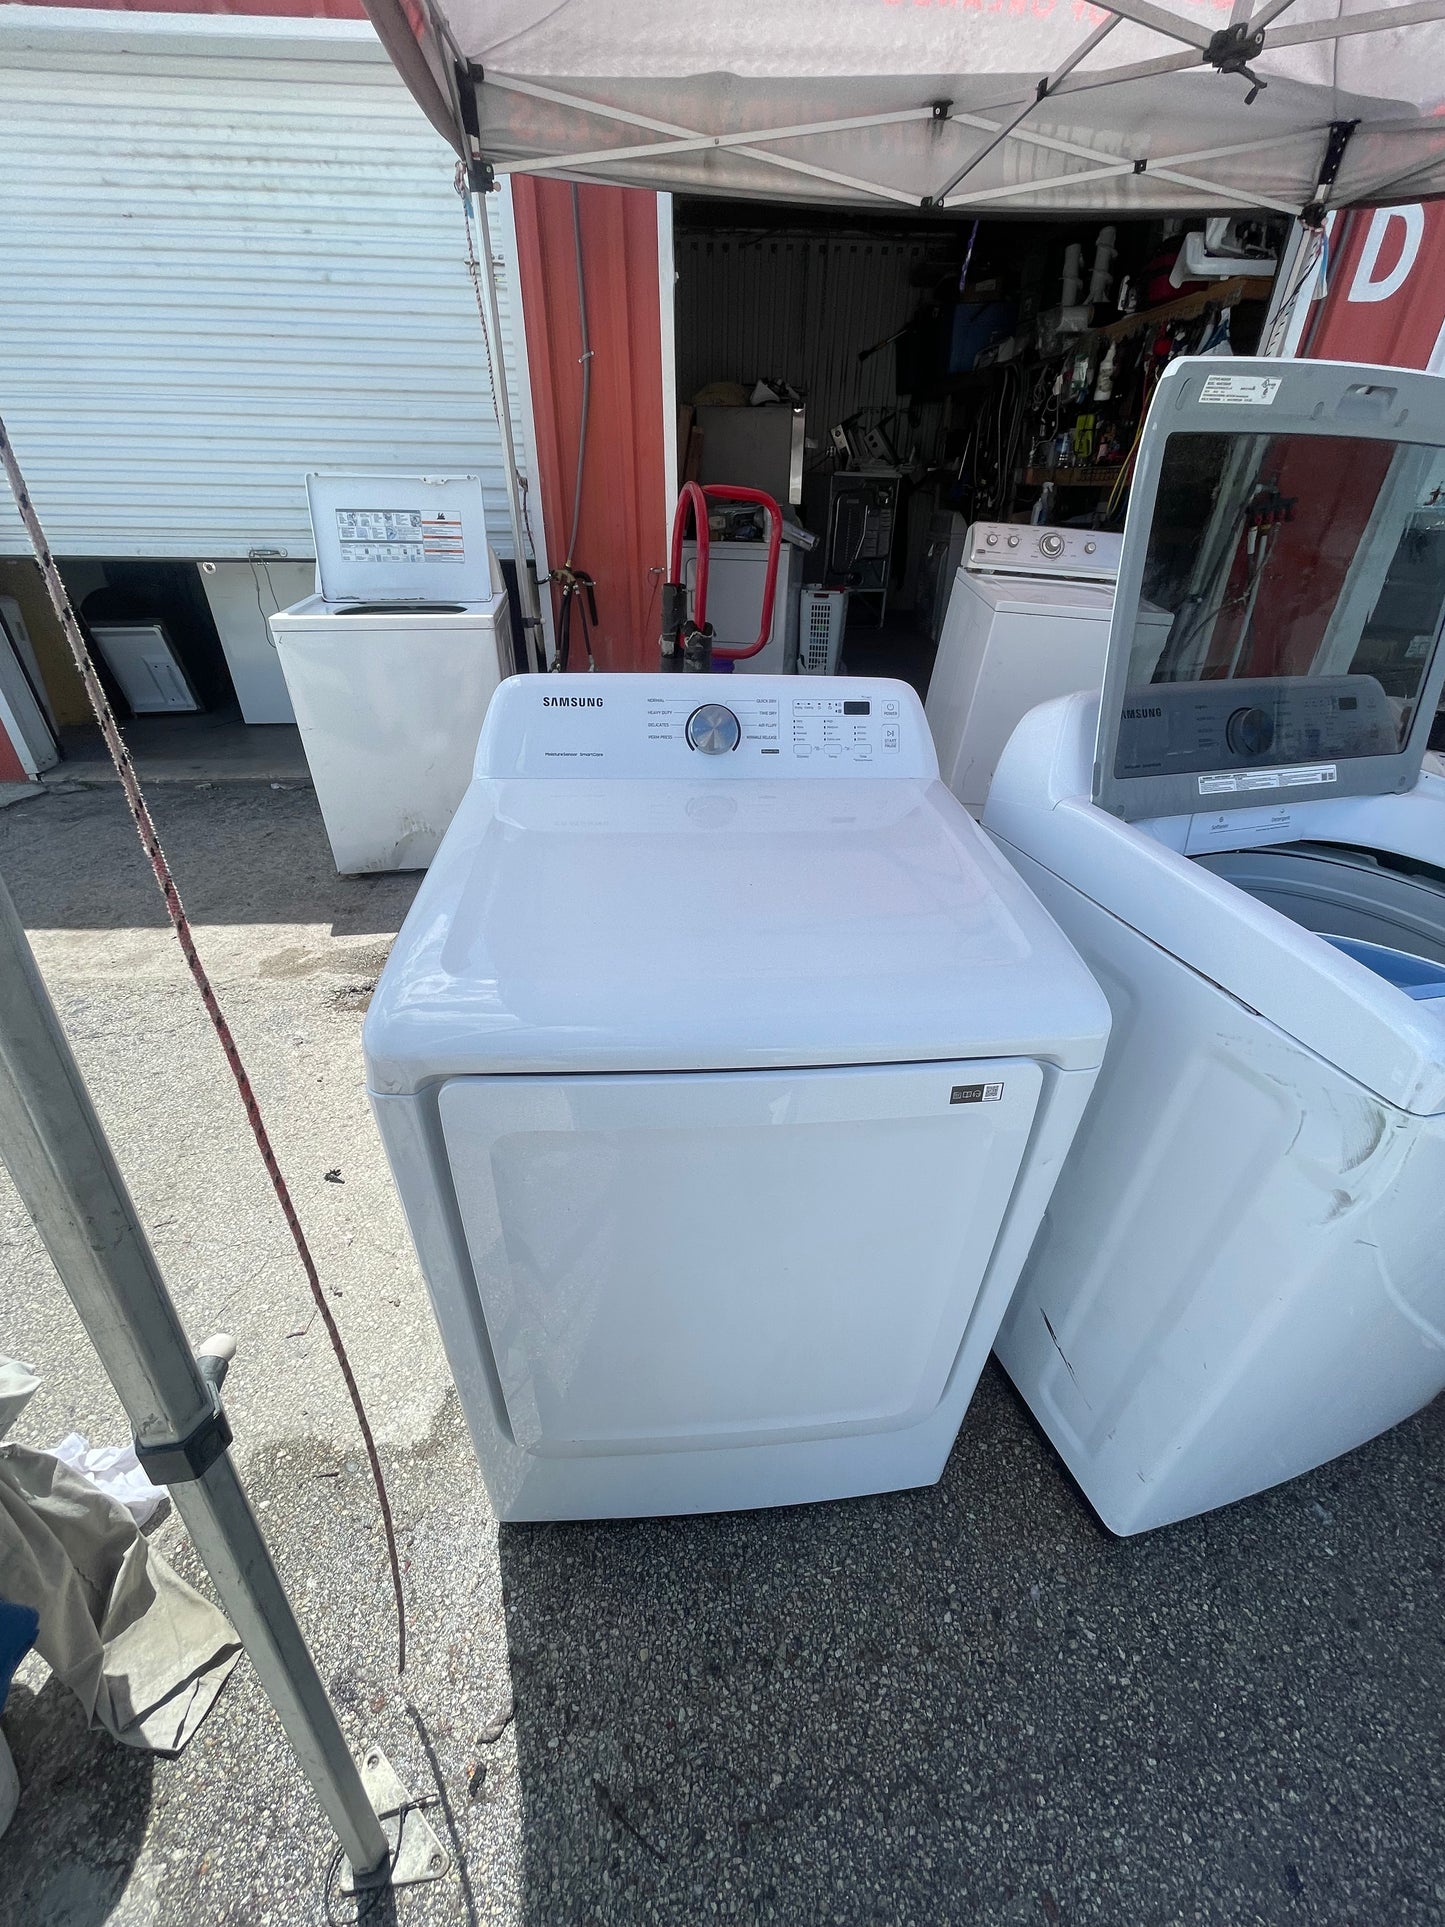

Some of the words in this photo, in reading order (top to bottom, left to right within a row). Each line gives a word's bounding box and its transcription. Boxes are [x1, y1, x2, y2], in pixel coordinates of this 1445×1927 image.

[1347, 203, 1425, 302] D
[543, 697, 603, 707] SAMSUNG
[1121, 707, 1162, 719] AMSUNG
